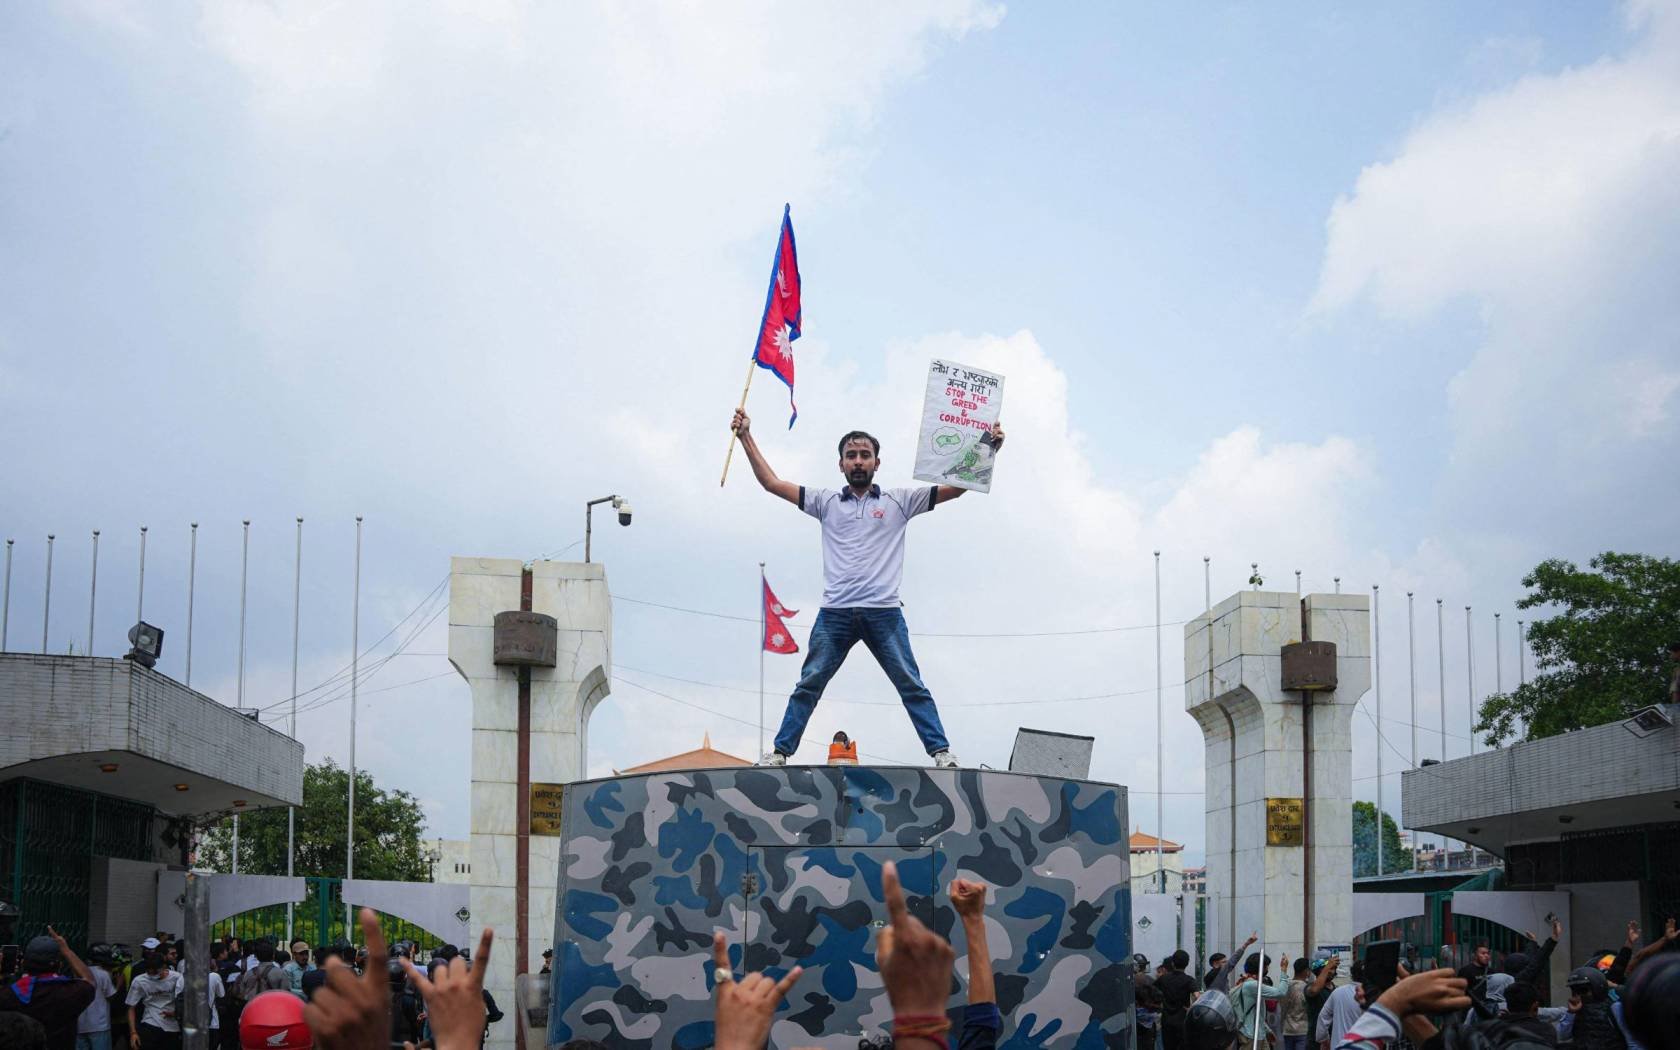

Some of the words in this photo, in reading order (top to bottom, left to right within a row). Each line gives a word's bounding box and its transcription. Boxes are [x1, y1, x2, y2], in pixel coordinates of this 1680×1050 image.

[953, 368, 960, 377] र
[945, 388, 965, 399] STOP
[971, 393, 988, 404] THE
[952, 399, 977, 410] GREED
[961, 409, 967, 417] &
[939, 414, 991, 432] CORRUPTION
